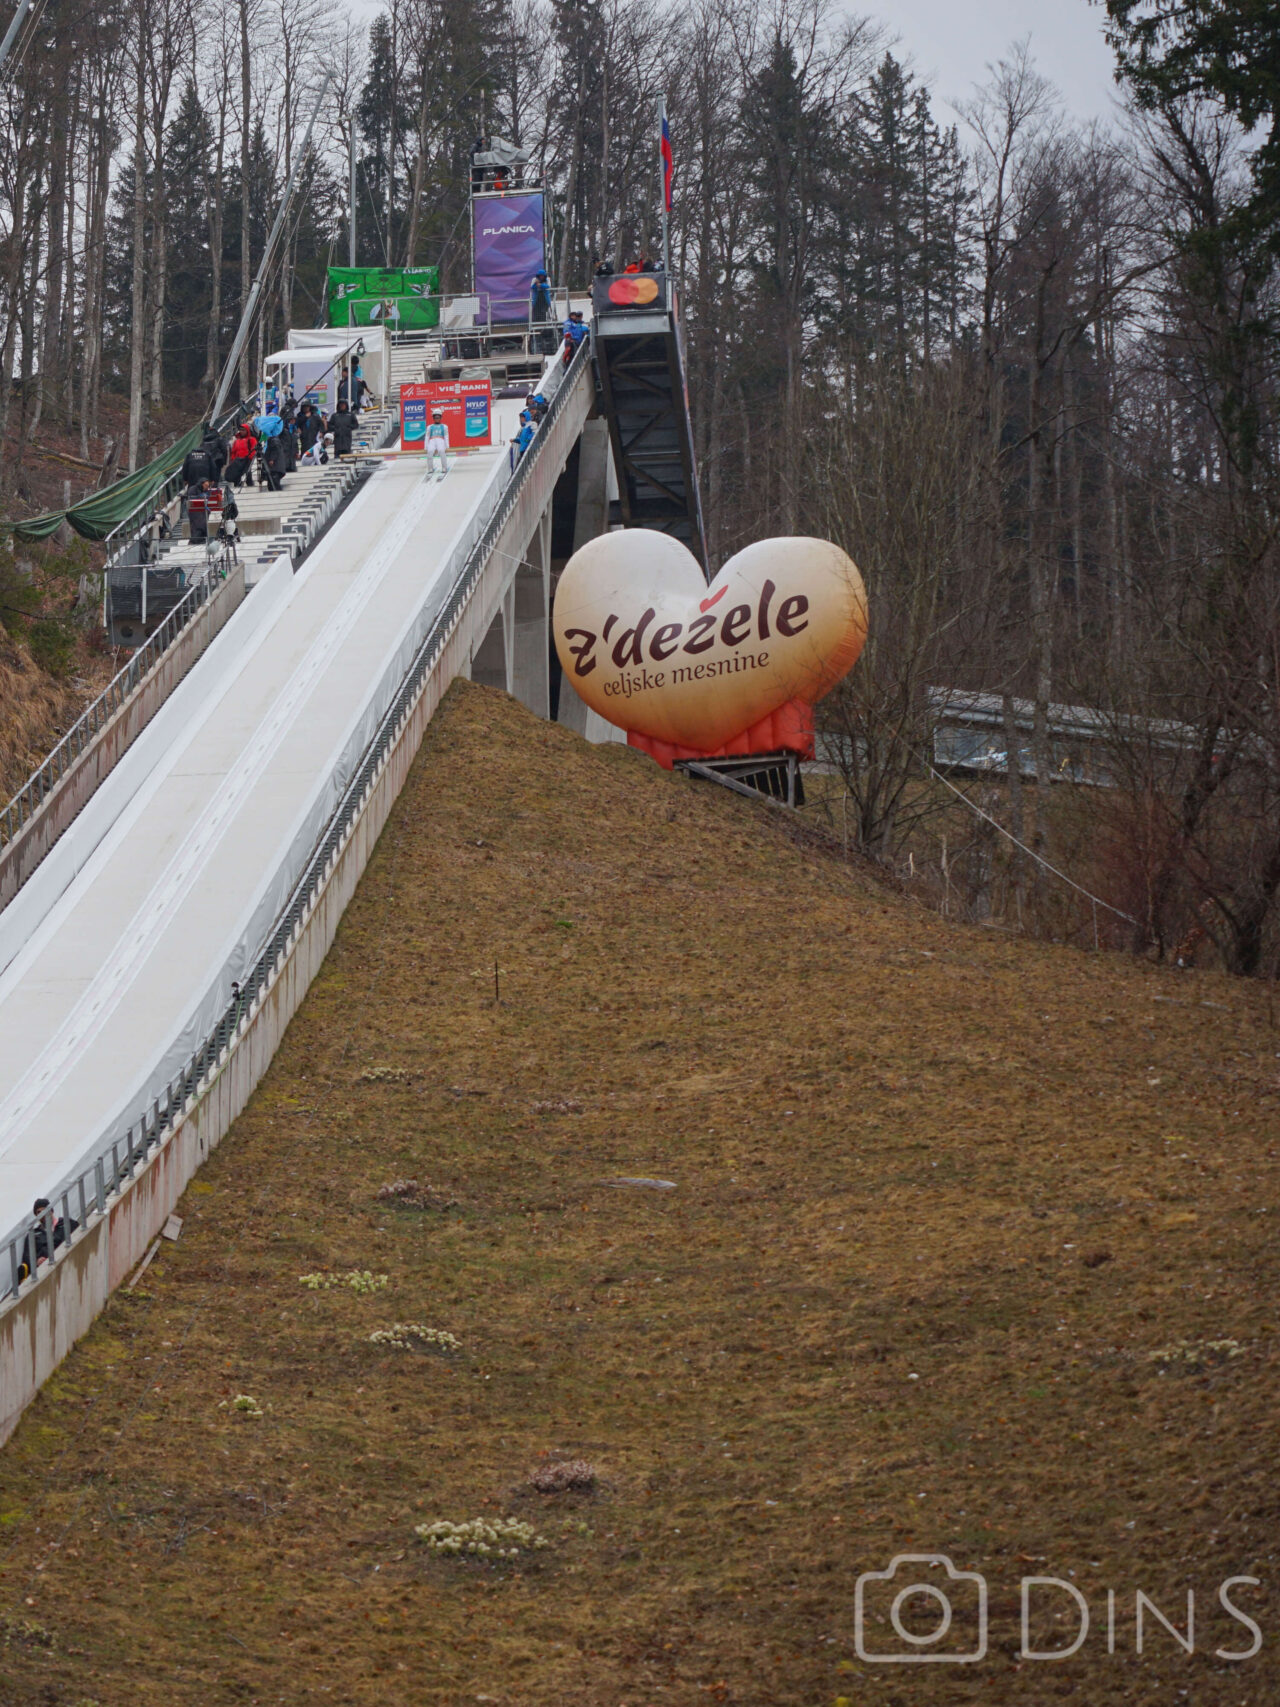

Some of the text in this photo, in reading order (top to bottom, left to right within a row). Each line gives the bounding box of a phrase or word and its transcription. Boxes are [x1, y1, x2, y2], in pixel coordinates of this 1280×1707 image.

[483, 225, 535, 236] PLANICA
[603, 651, 770, 698] celjske mesnine
